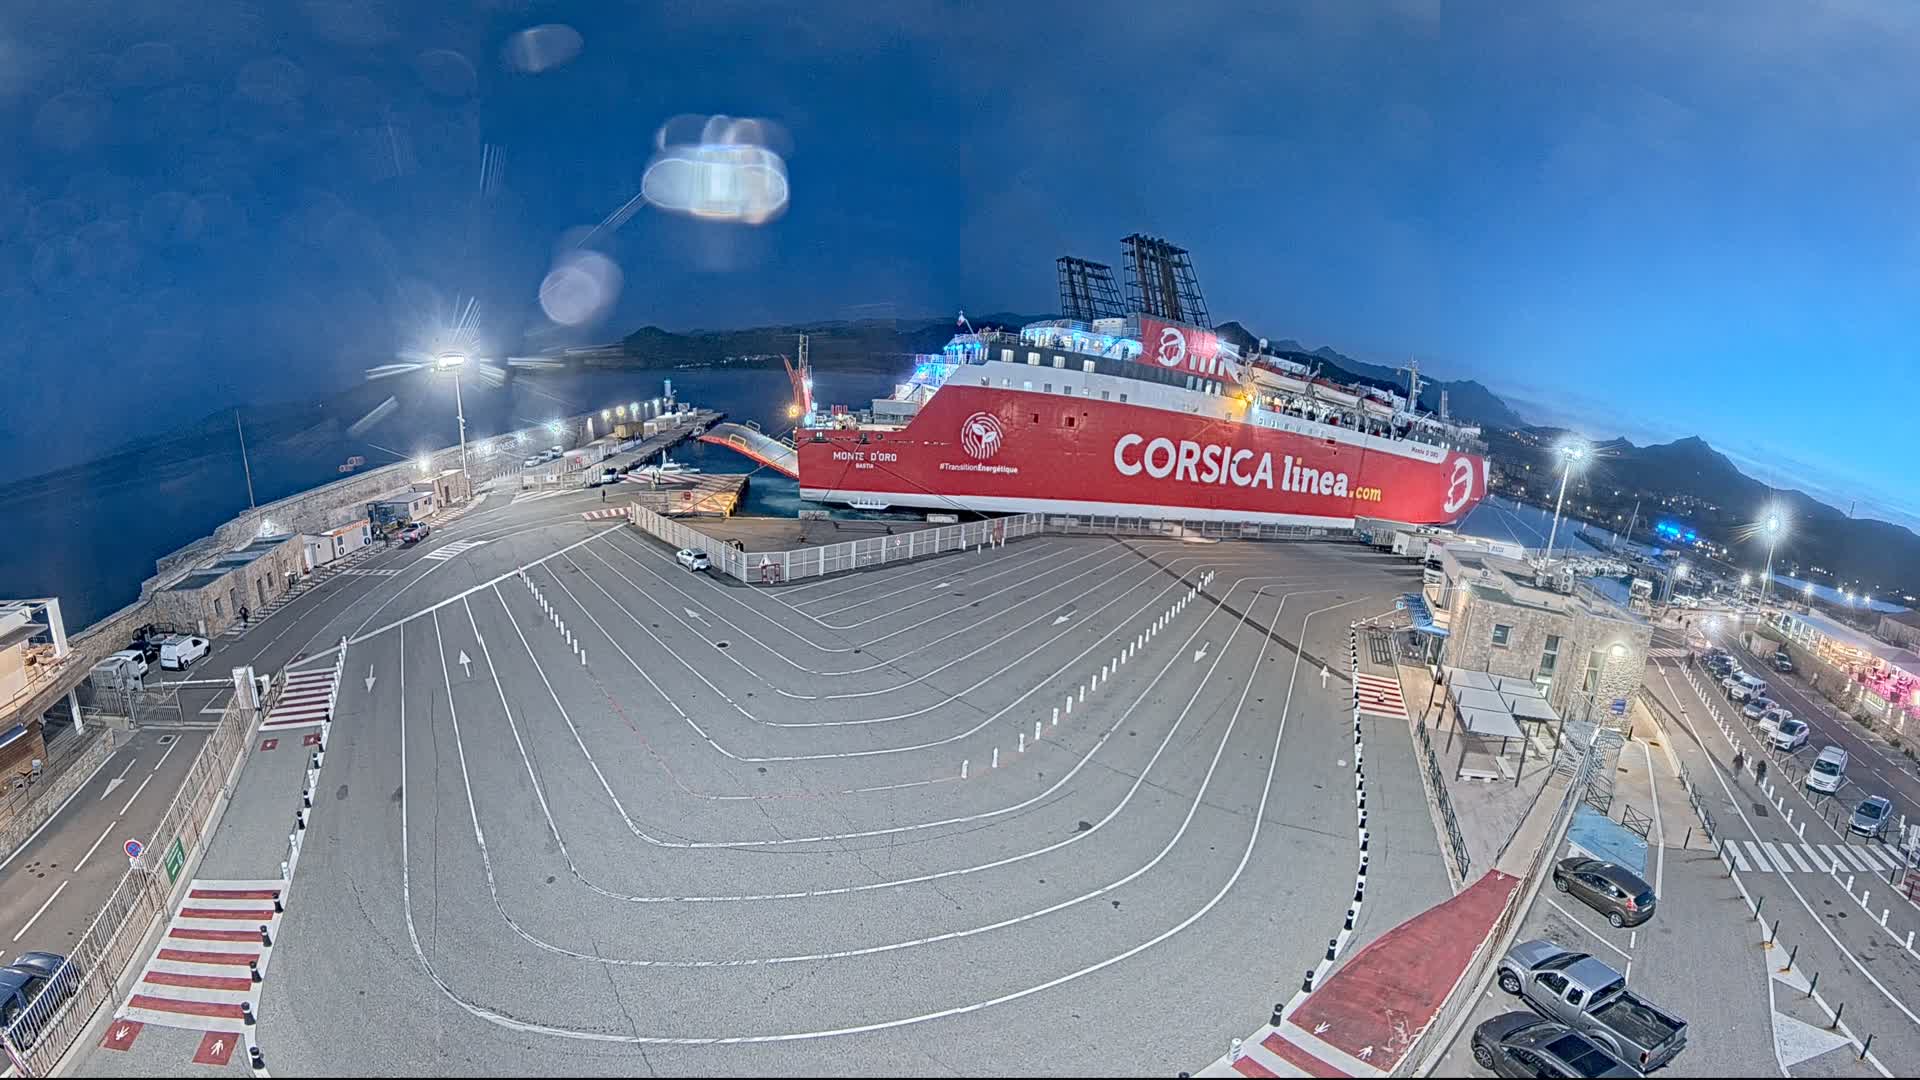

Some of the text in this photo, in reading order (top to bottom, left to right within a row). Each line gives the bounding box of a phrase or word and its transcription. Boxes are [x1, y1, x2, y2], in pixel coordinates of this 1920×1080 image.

[833, 450, 897, 462] MONTE D'ORO
[1113, 433, 1273, 490] CORSICA
